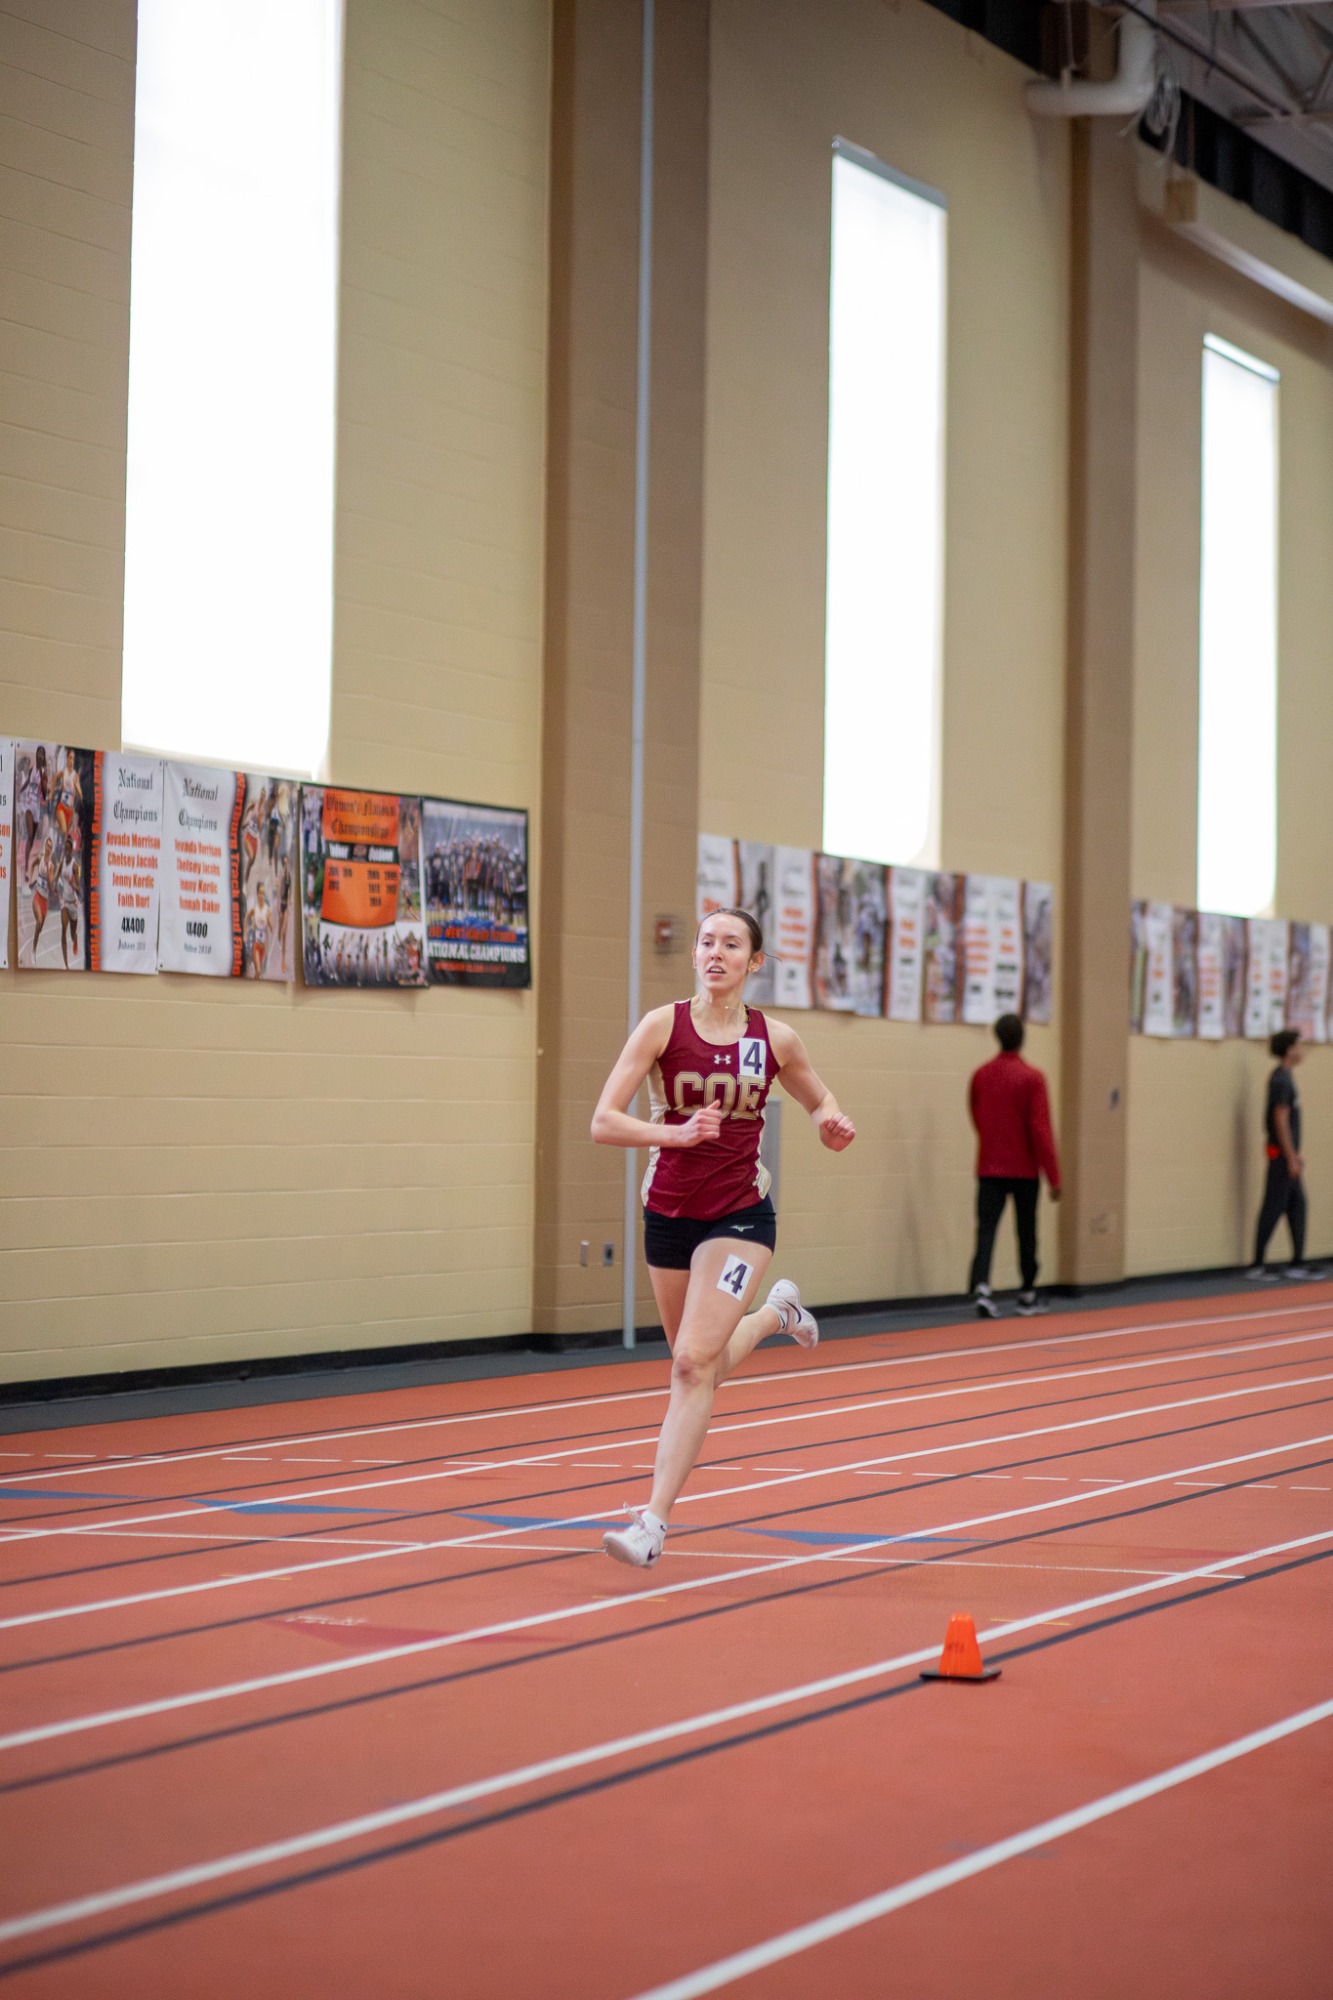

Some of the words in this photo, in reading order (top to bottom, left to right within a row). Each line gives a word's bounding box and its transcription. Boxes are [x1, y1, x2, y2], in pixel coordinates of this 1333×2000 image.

[118, 767, 153, 793] National
[183, 778, 219, 801] National
[113, 799, 158, 825] Champions
[131, 833, 161, 850] Morrison
[107, 851, 135, 869] Chelsey
[112, 872, 132, 889] Jenny
[121, 916, 145, 934] 4X400
[742, 1041, 763, 1075] 4
[673, 1071, 766, 1120] COE
[723, 1263, 748, 1295] 4
